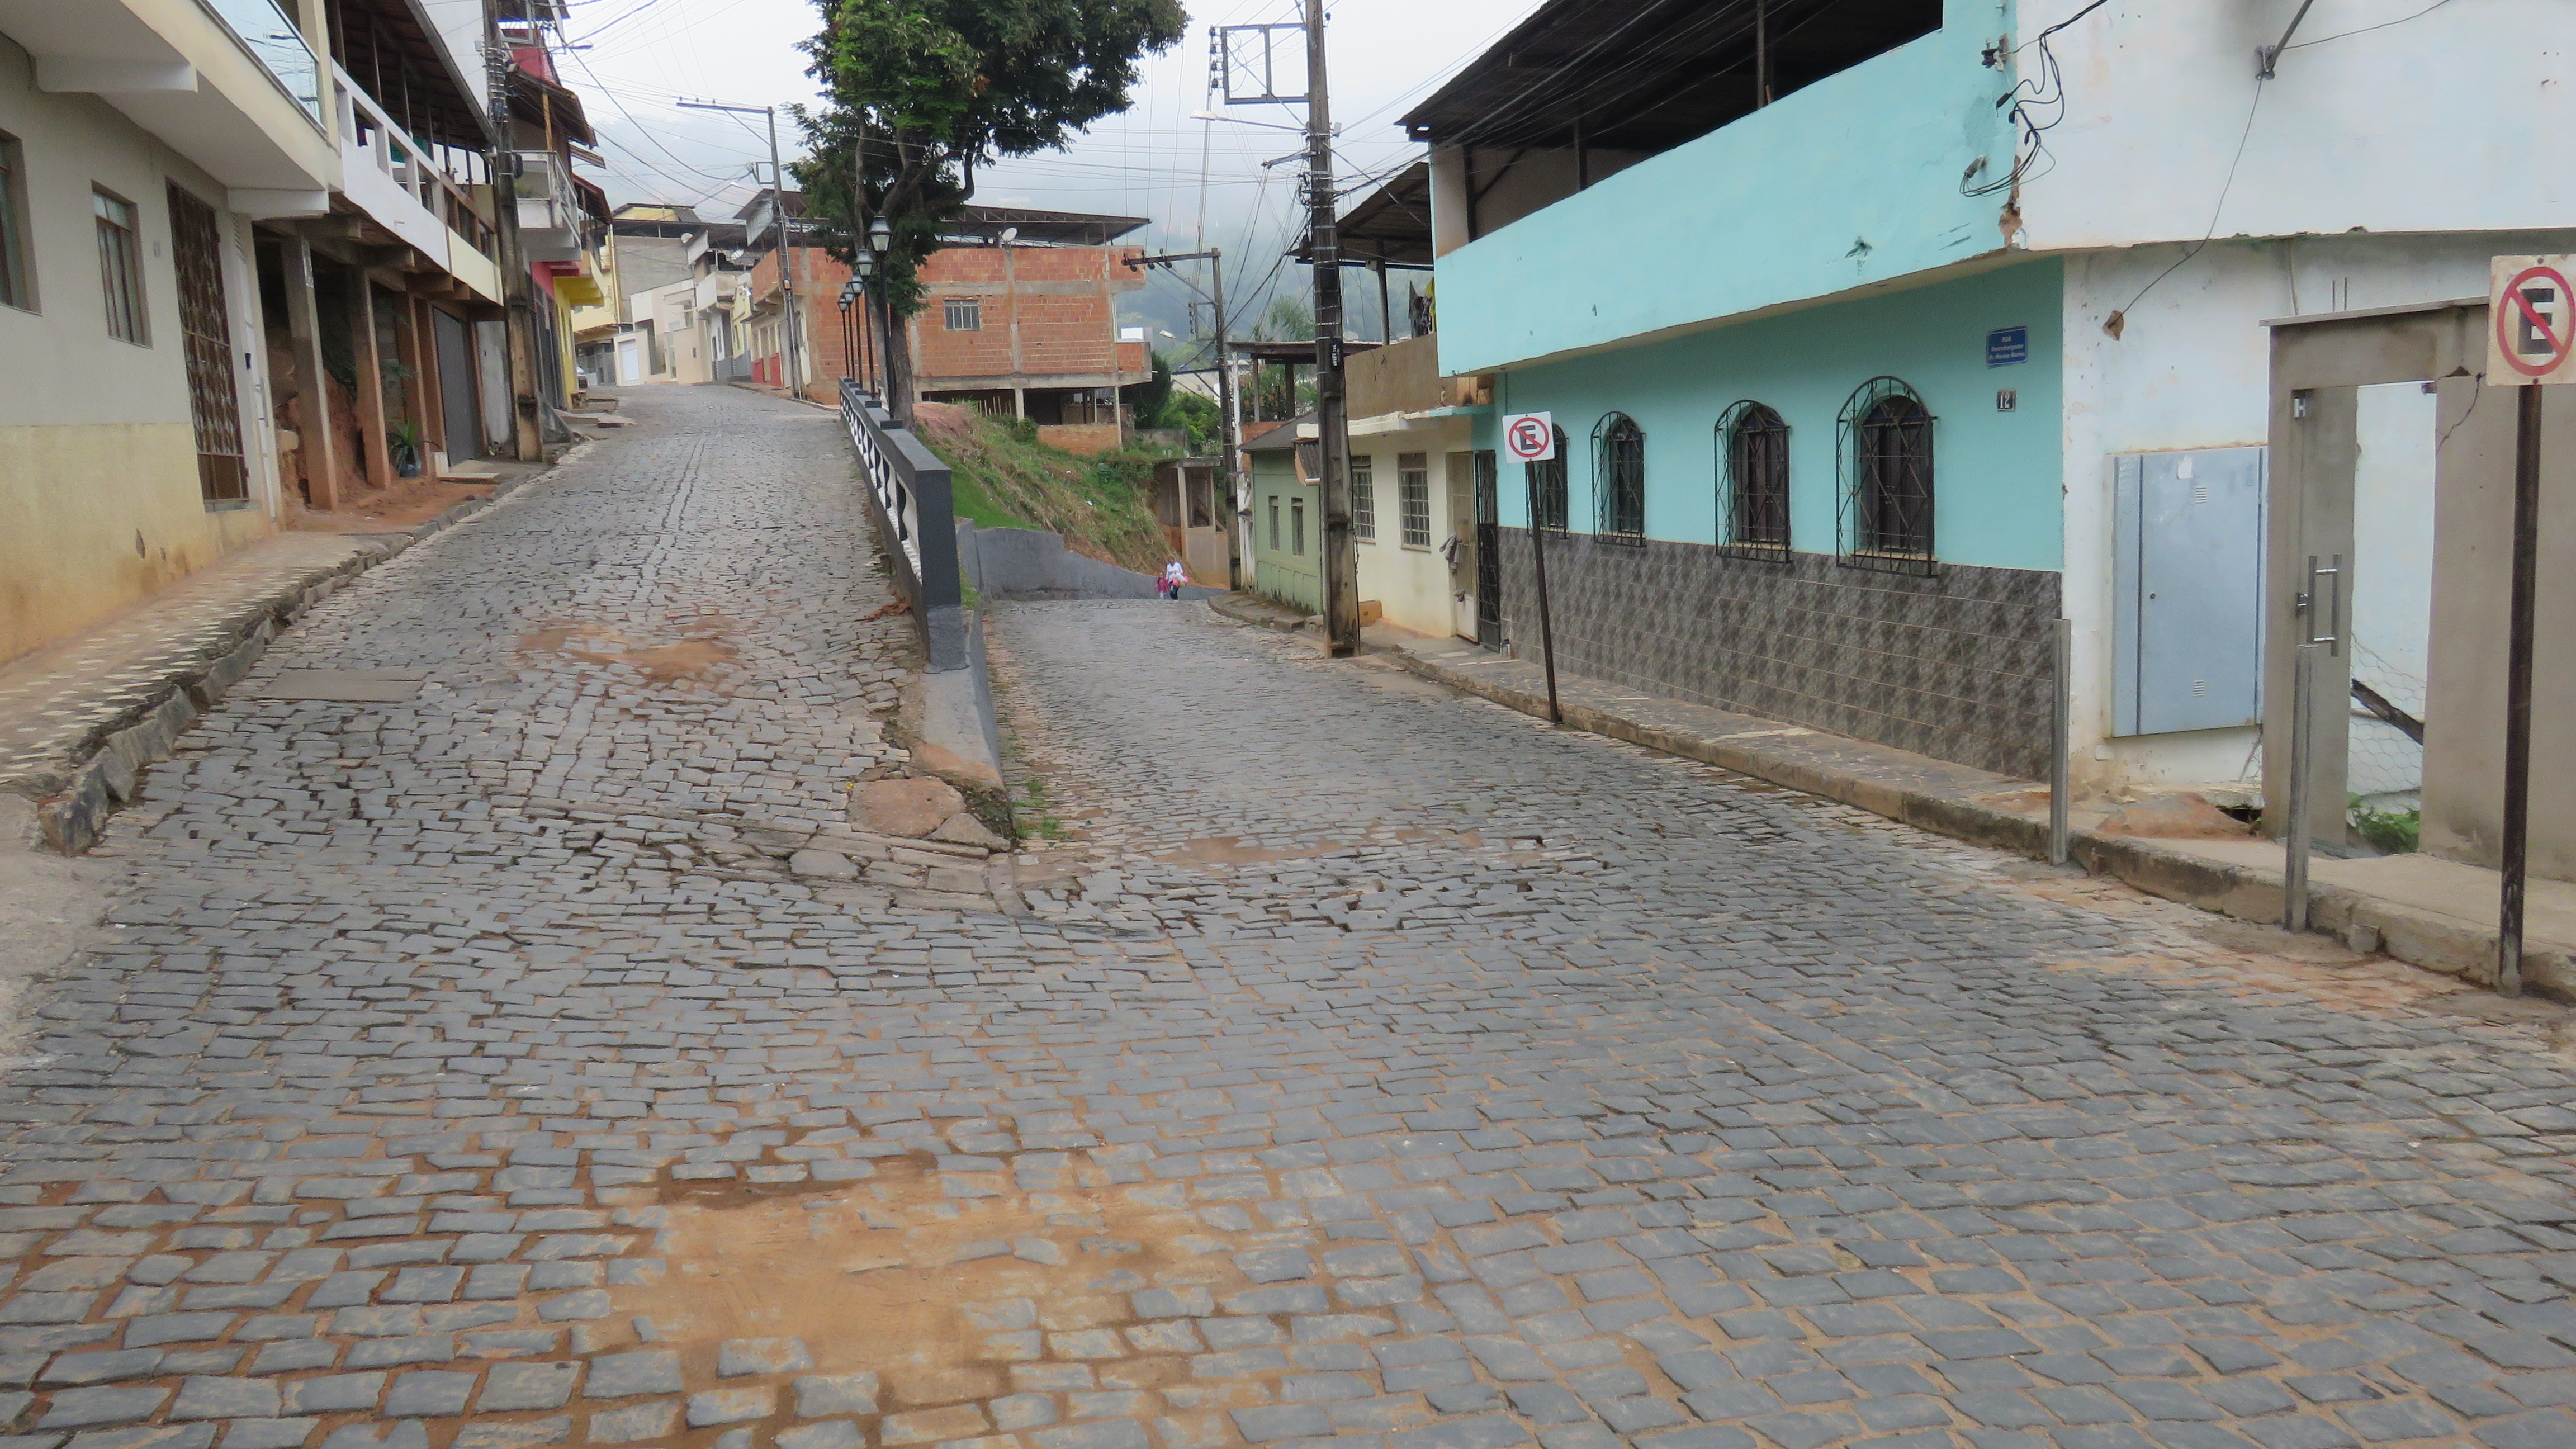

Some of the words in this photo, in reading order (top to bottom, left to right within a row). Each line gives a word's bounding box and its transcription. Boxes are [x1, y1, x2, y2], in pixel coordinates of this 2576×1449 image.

[2518, 288, 2555, 354] E
[2000, 392, 2010, 409] 12
[1519, 425, 1537, 451] E
